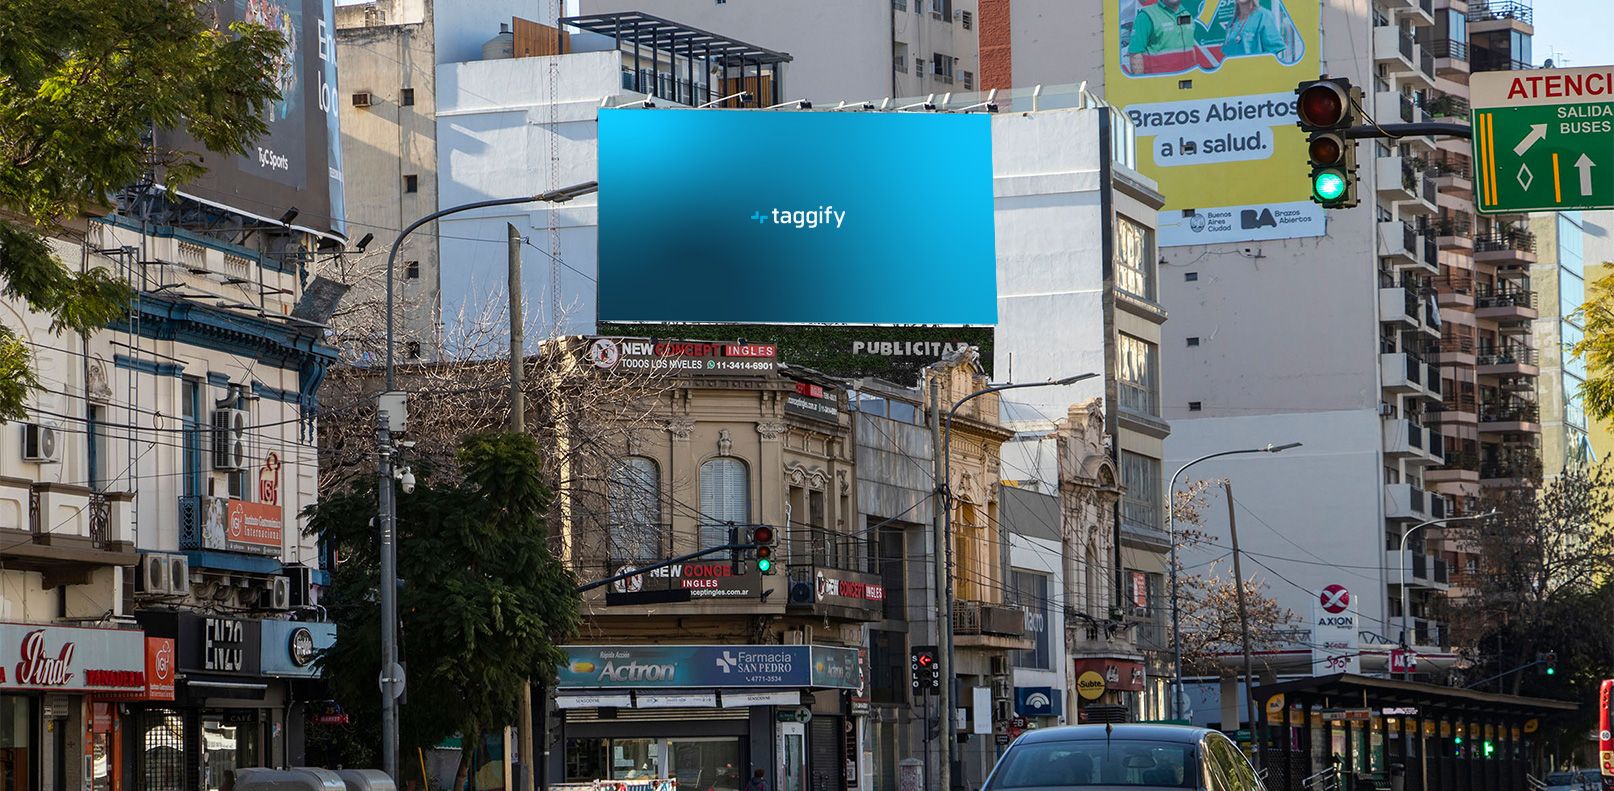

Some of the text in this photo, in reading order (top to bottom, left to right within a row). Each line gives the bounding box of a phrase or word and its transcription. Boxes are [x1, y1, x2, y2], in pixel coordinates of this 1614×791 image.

[1507, 73, 1612, 99] ATENCI
[1129, 99, 1298, 128] Brazos Abiertos
[1557, 105, 1613, 118] SALIDA
[1560, 121, 1611, 134] BUSES
[1160, 131, 1267, 157] a la salud.
[258, 147, 289, 171] TyC Sports
[771, 205, 846, 229] taggify
[1241, 208, 1278, 230] BA
[1274, 209, 1301, 217] Brazos
[1278, 216, 1312, 224] Abiertos
[1207, 225, 1232, 233] Ciudad
[621, 342, 774, 356] NEW CONCEPT INGLES
[621, 359, 773, 370] TODOS LOS NIVELES 11-3414-6901
[650, 564, 732, 577] NEW CONCE
[682, 579, 718, 588] INGLES
[865, 585, 882, 599] INGLES
[1318, 617, 1353, 626] AXION
[738, 651, 792, 663] Farmacia
[598, 660, 675, 682] Actron
[737, 663, 792, 673] SAN PEDRO
[912, 655, 920, 688] SOLO
[1080, 680, 1102, 689] Subte
